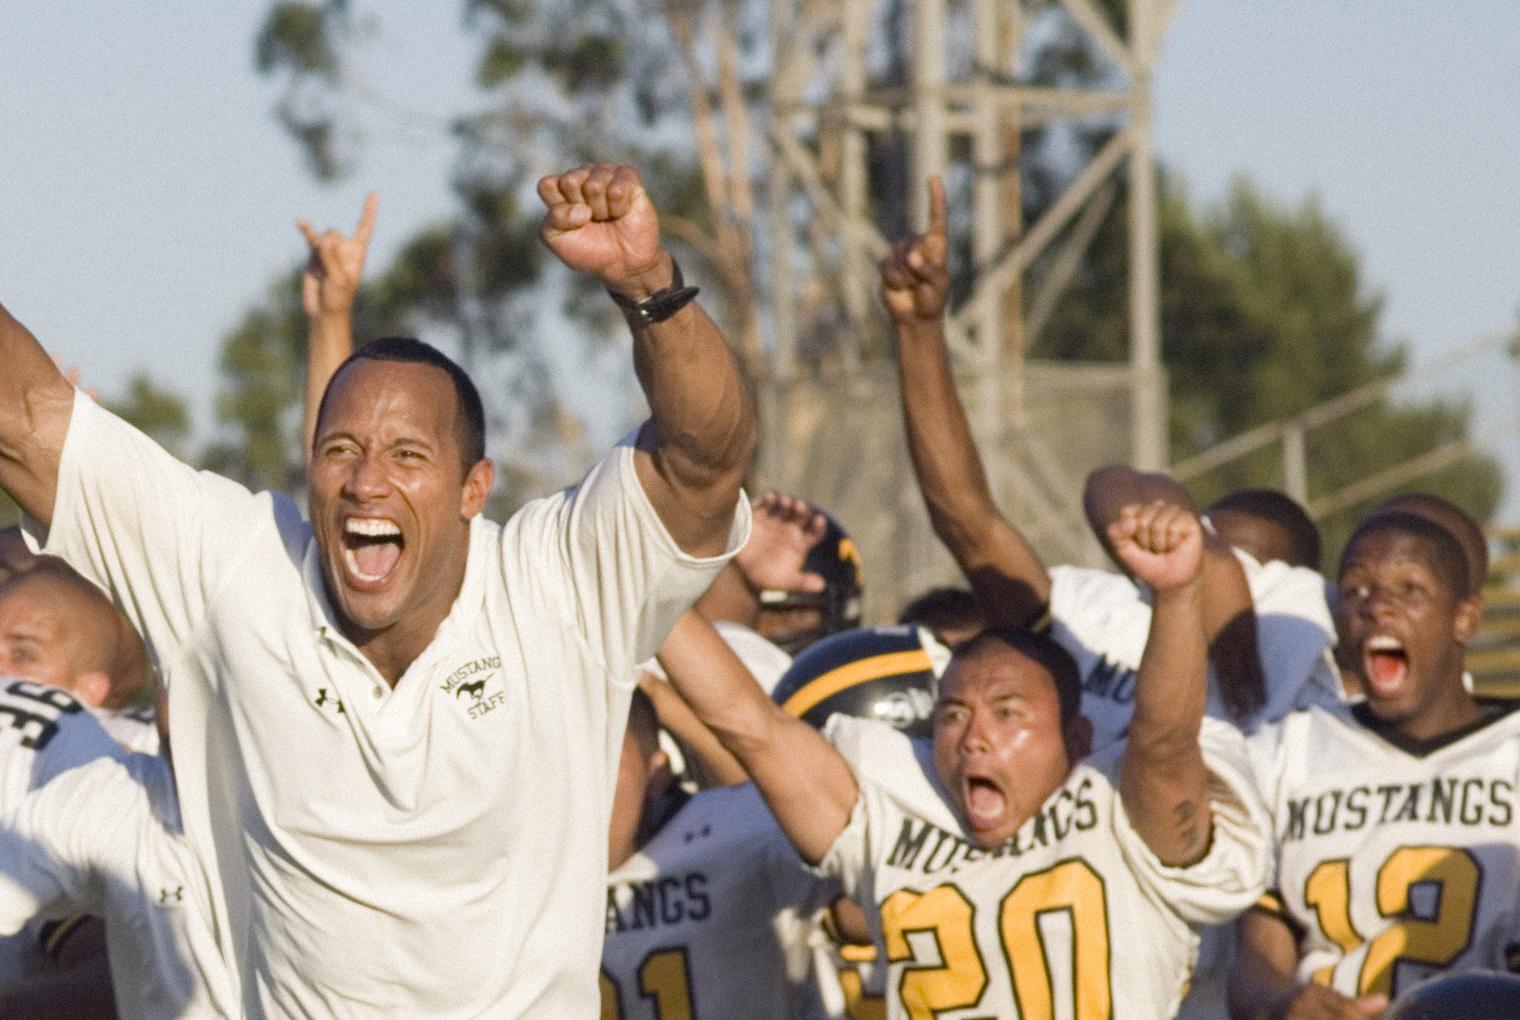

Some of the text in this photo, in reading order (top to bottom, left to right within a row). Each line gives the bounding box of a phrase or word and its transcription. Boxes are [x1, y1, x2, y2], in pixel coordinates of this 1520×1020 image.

[439, 656, 501, 694] MUSTANG
[467, 690, 505, 720] STAFF
[887, 778, 1097, 875] MUNGS
[1282, 777, 1513, 841] MUSTANGS
[605, 871, 712, 934] ANGS
